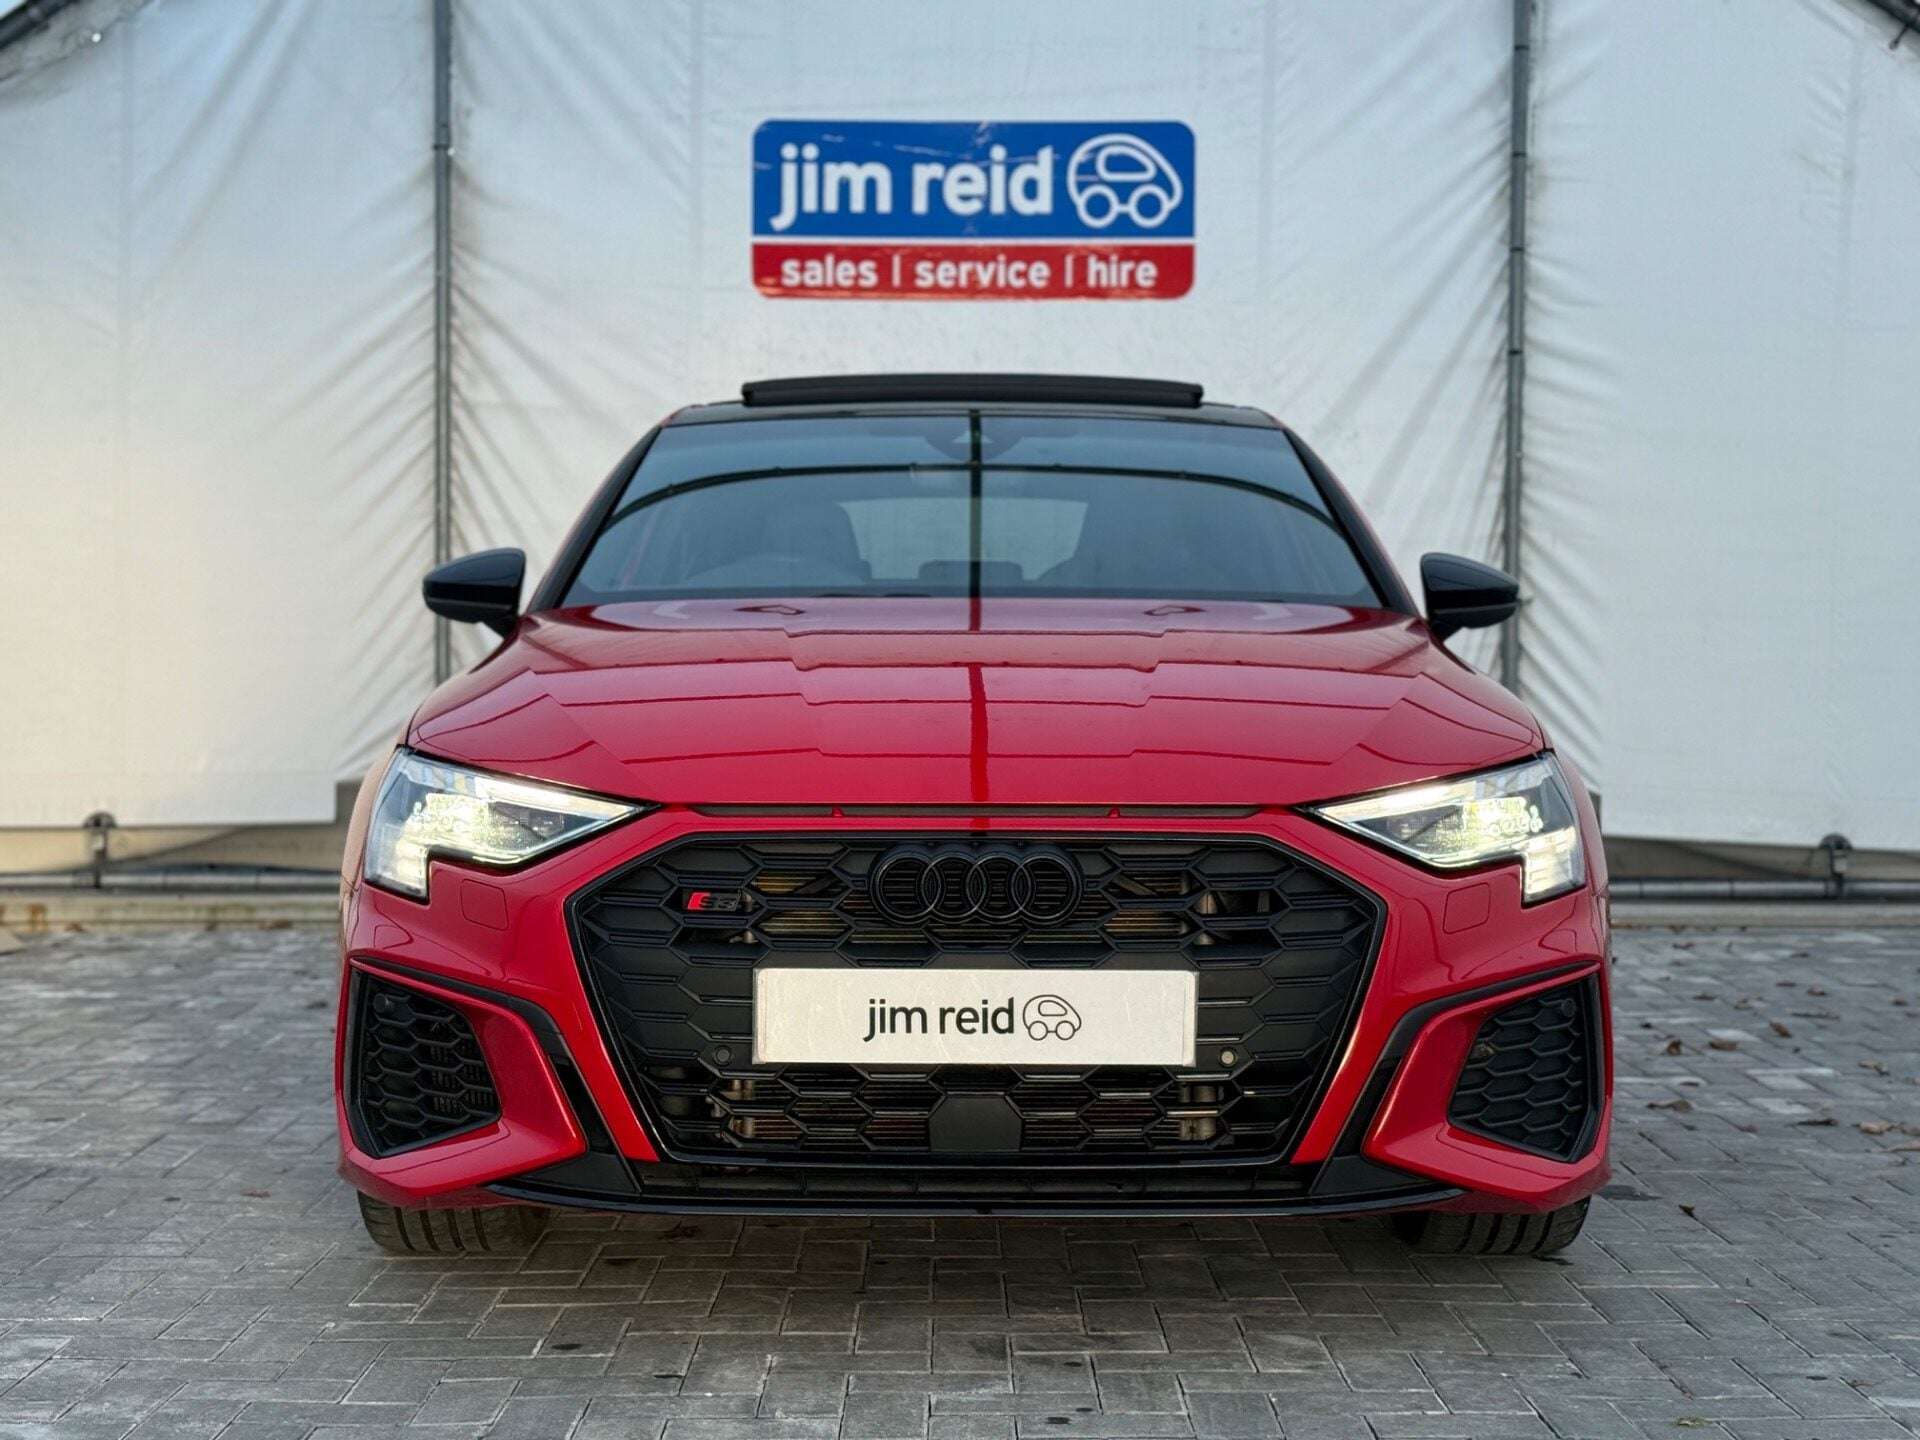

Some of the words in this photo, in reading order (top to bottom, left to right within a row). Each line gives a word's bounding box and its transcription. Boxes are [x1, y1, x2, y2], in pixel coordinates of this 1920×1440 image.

[770, 143, 892, 232] jim
[912, 144, 1053, 216] reid
[781, 254, 878, 288] sales
[914, 254, 1051, 288] service
[1087, 254, 1158, 288] hire
[863, 998, 928, 1043] jim
[939, 996, 1015, 1035] reid
